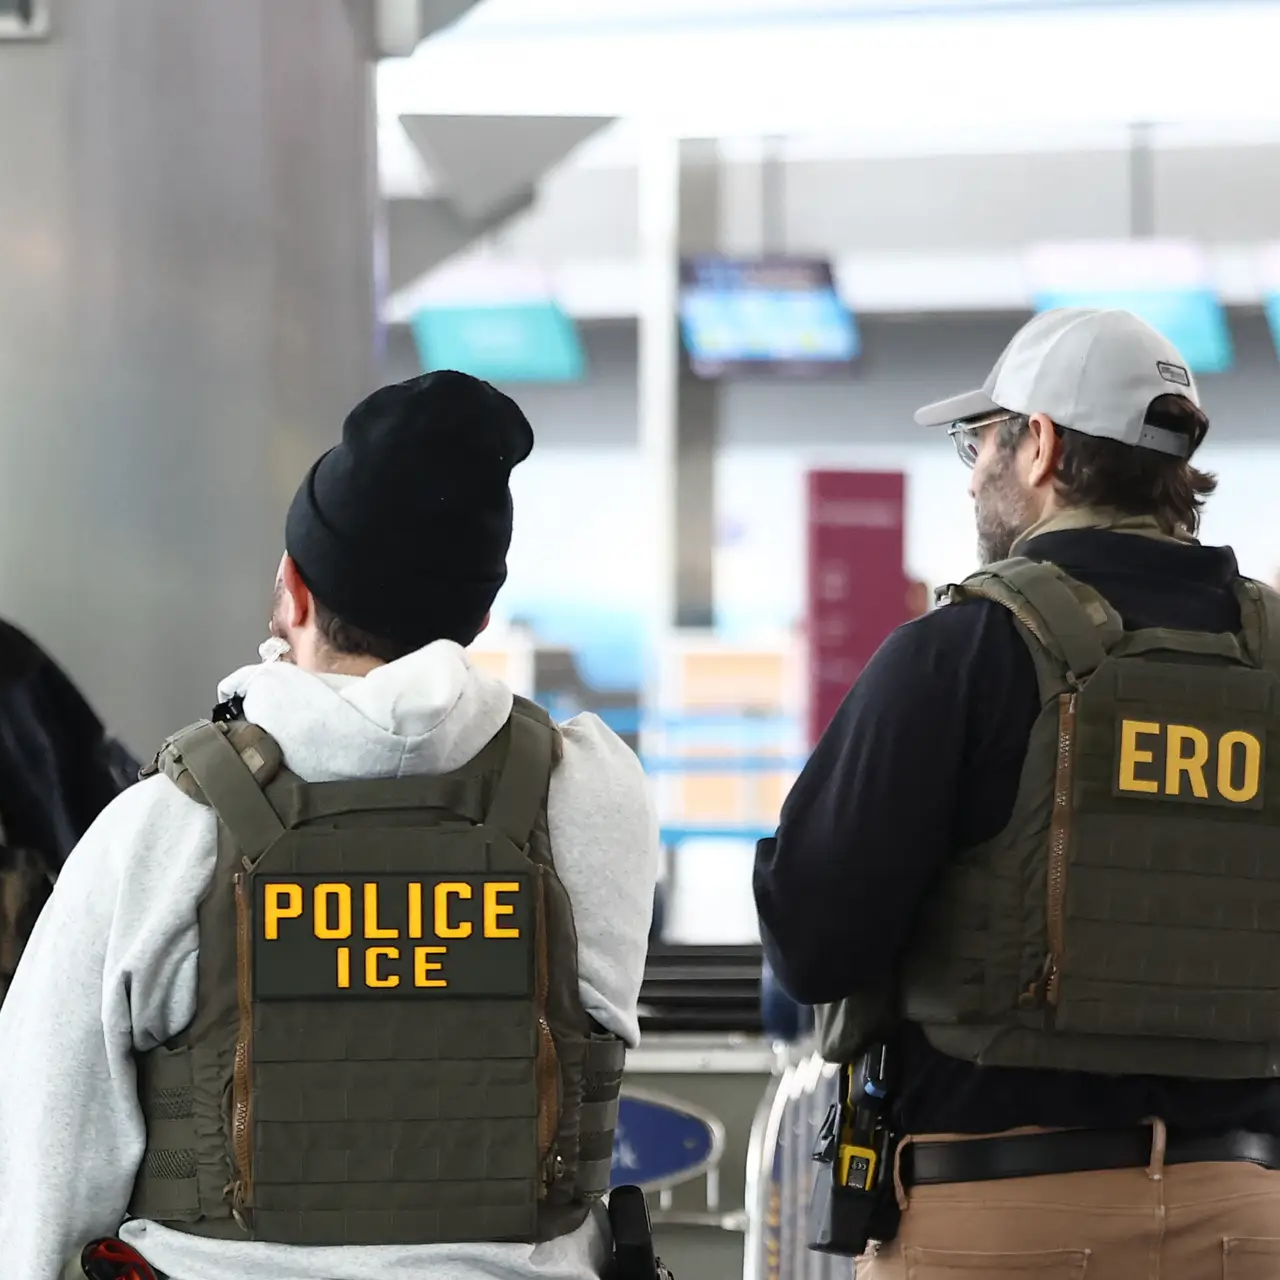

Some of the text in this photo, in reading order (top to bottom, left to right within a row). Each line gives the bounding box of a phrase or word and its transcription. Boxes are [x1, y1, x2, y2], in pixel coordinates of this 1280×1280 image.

[1119, 720, 1260, 801] ERO
[265, 883, 519, 939] POLICE
[338, 947, 447, 987] ICE
